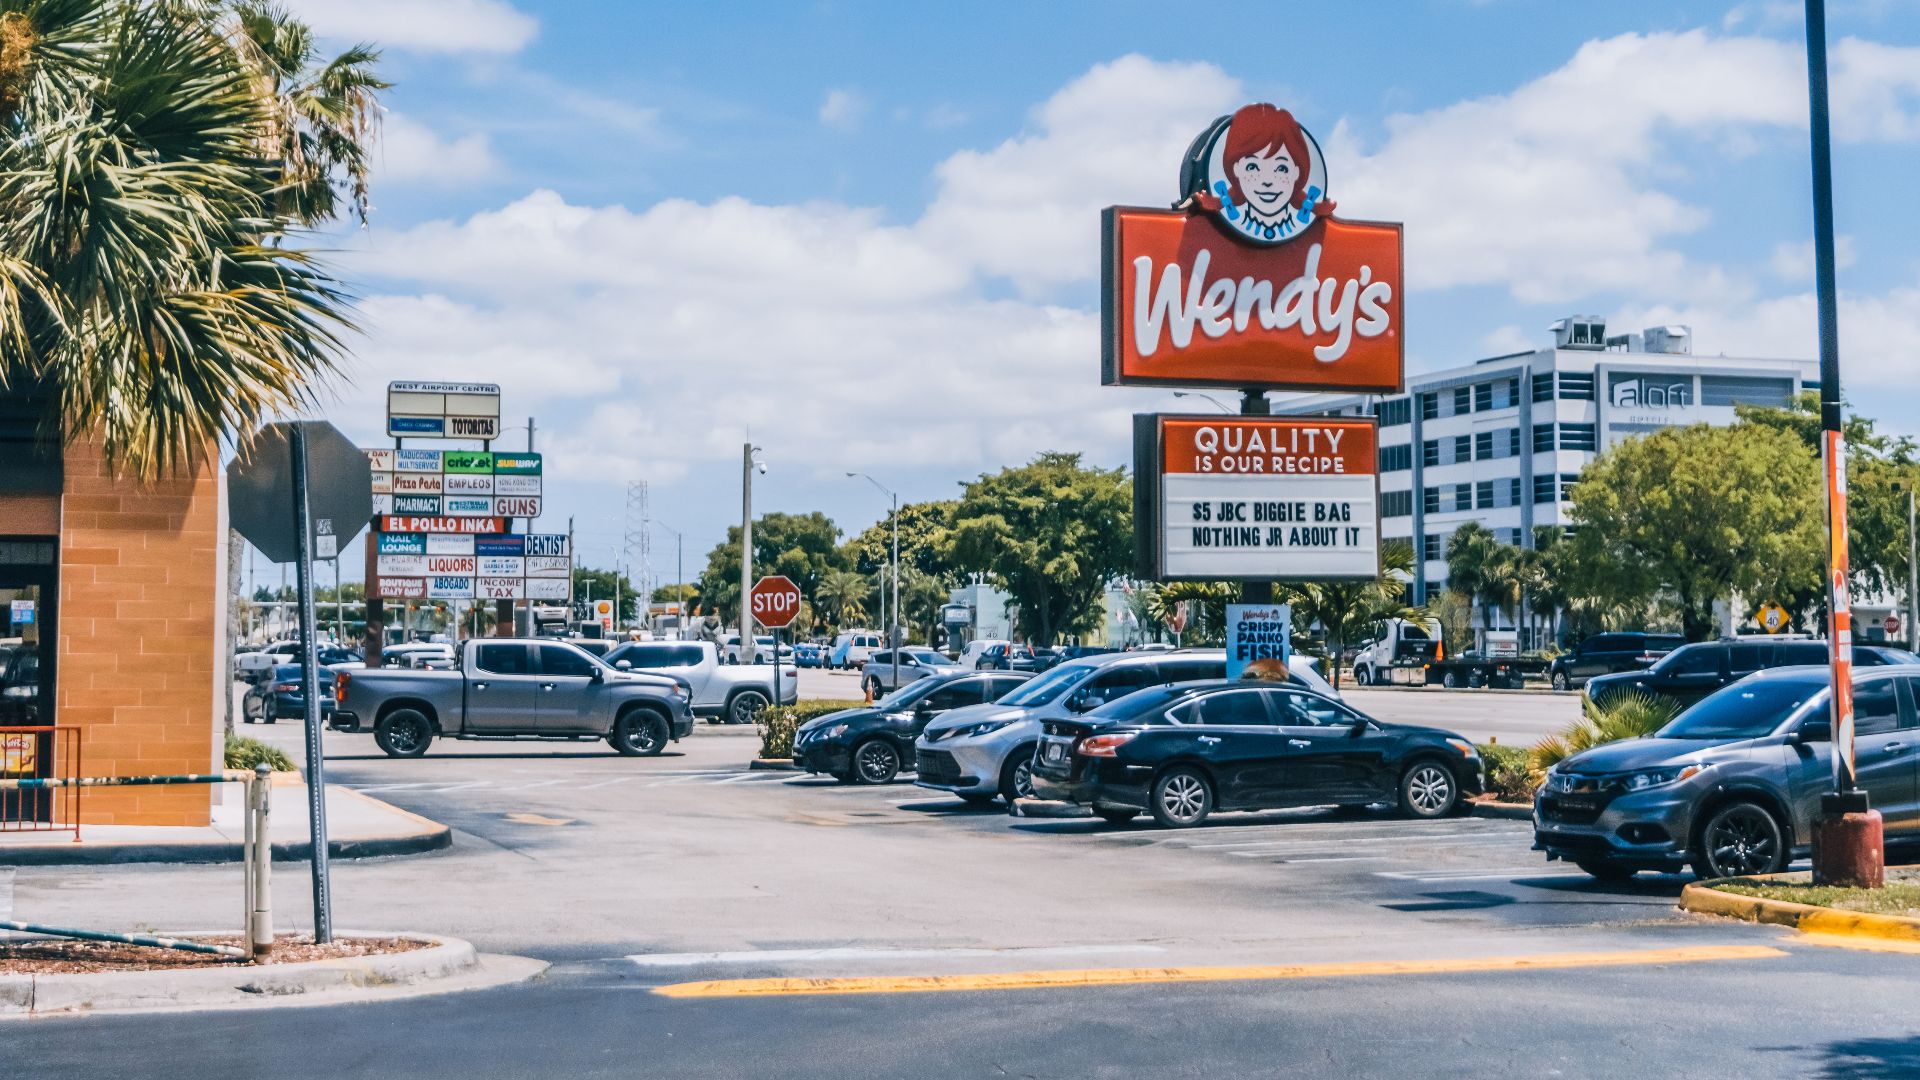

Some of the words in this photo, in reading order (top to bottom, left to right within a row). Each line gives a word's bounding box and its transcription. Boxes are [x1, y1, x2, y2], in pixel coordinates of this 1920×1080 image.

[1133, 243, 1392, 362] Wendy's
[462, 385, 496, 393] CENTRE
[1613, 378, 1688, 409] aloft
[451, 418, 494, 436] TOTORITAS
[1194, 426, 1345, 455] QUALITY
[397, 451, 440, 461] TRADUCCIONES
[448, 456, 491, 468] cricket
[398, 460, 439, 470] MULTISERVICE
[496, 459, 540, 469] SUBWAY
[1194, 455, 1213, 472] IS
[1219, 455, 1265, 472] OUR
[1272, 456, 1344, 473] RECIPE
[394, 476, 416, 489] Pizza
[418, 476, 441, 490] Pasta
[448, 478, 491, 489] EMPLEOS
[395, 497, 440, 512] PHARMACY
[496, 498, 537, 516] GUNS
[1216, 501, 1248, 522] JBC
[1253, 501, 1306, 522] BIGGIE
[1314, 502, 1351, 522] BAG
[389, 517, 407, 531] EL
[410, 517, 457, 532] POLLO
[460, 518, 497, 532] INKA
[386, 535, 411, 543] NAIL
[1192, 526, 1261, 547] NOTHING
[1266, 526, 1283, 546] JR
[1288, 526, 1338, 546] ABOUT
[1344, 526, 1360, 546] IT
[381, 544, 422, 552] LOUNGE
[526, 536, 566, 555] DENTIST
[428, 558, 474, 573] LIQUORS
[379, 578, 423, 588] BOUTIQUE
[433, 578, 470, 590] ABOGADO
[480, 579, 522, 587] INCOME
[485, 588, 514, 598] TAX
[753, 592, 796, 613] STOP
[1242, 609, 1270, 621] Wendy's
[1766, 616, 1778, 626] 40
[1236, 621, 1284, 632] CRISPY
[1884, 621, 1899, 630] STOP
[1236, 632, 1284, 644] PANKO
[1236, 644, 1284, 662] FISH
